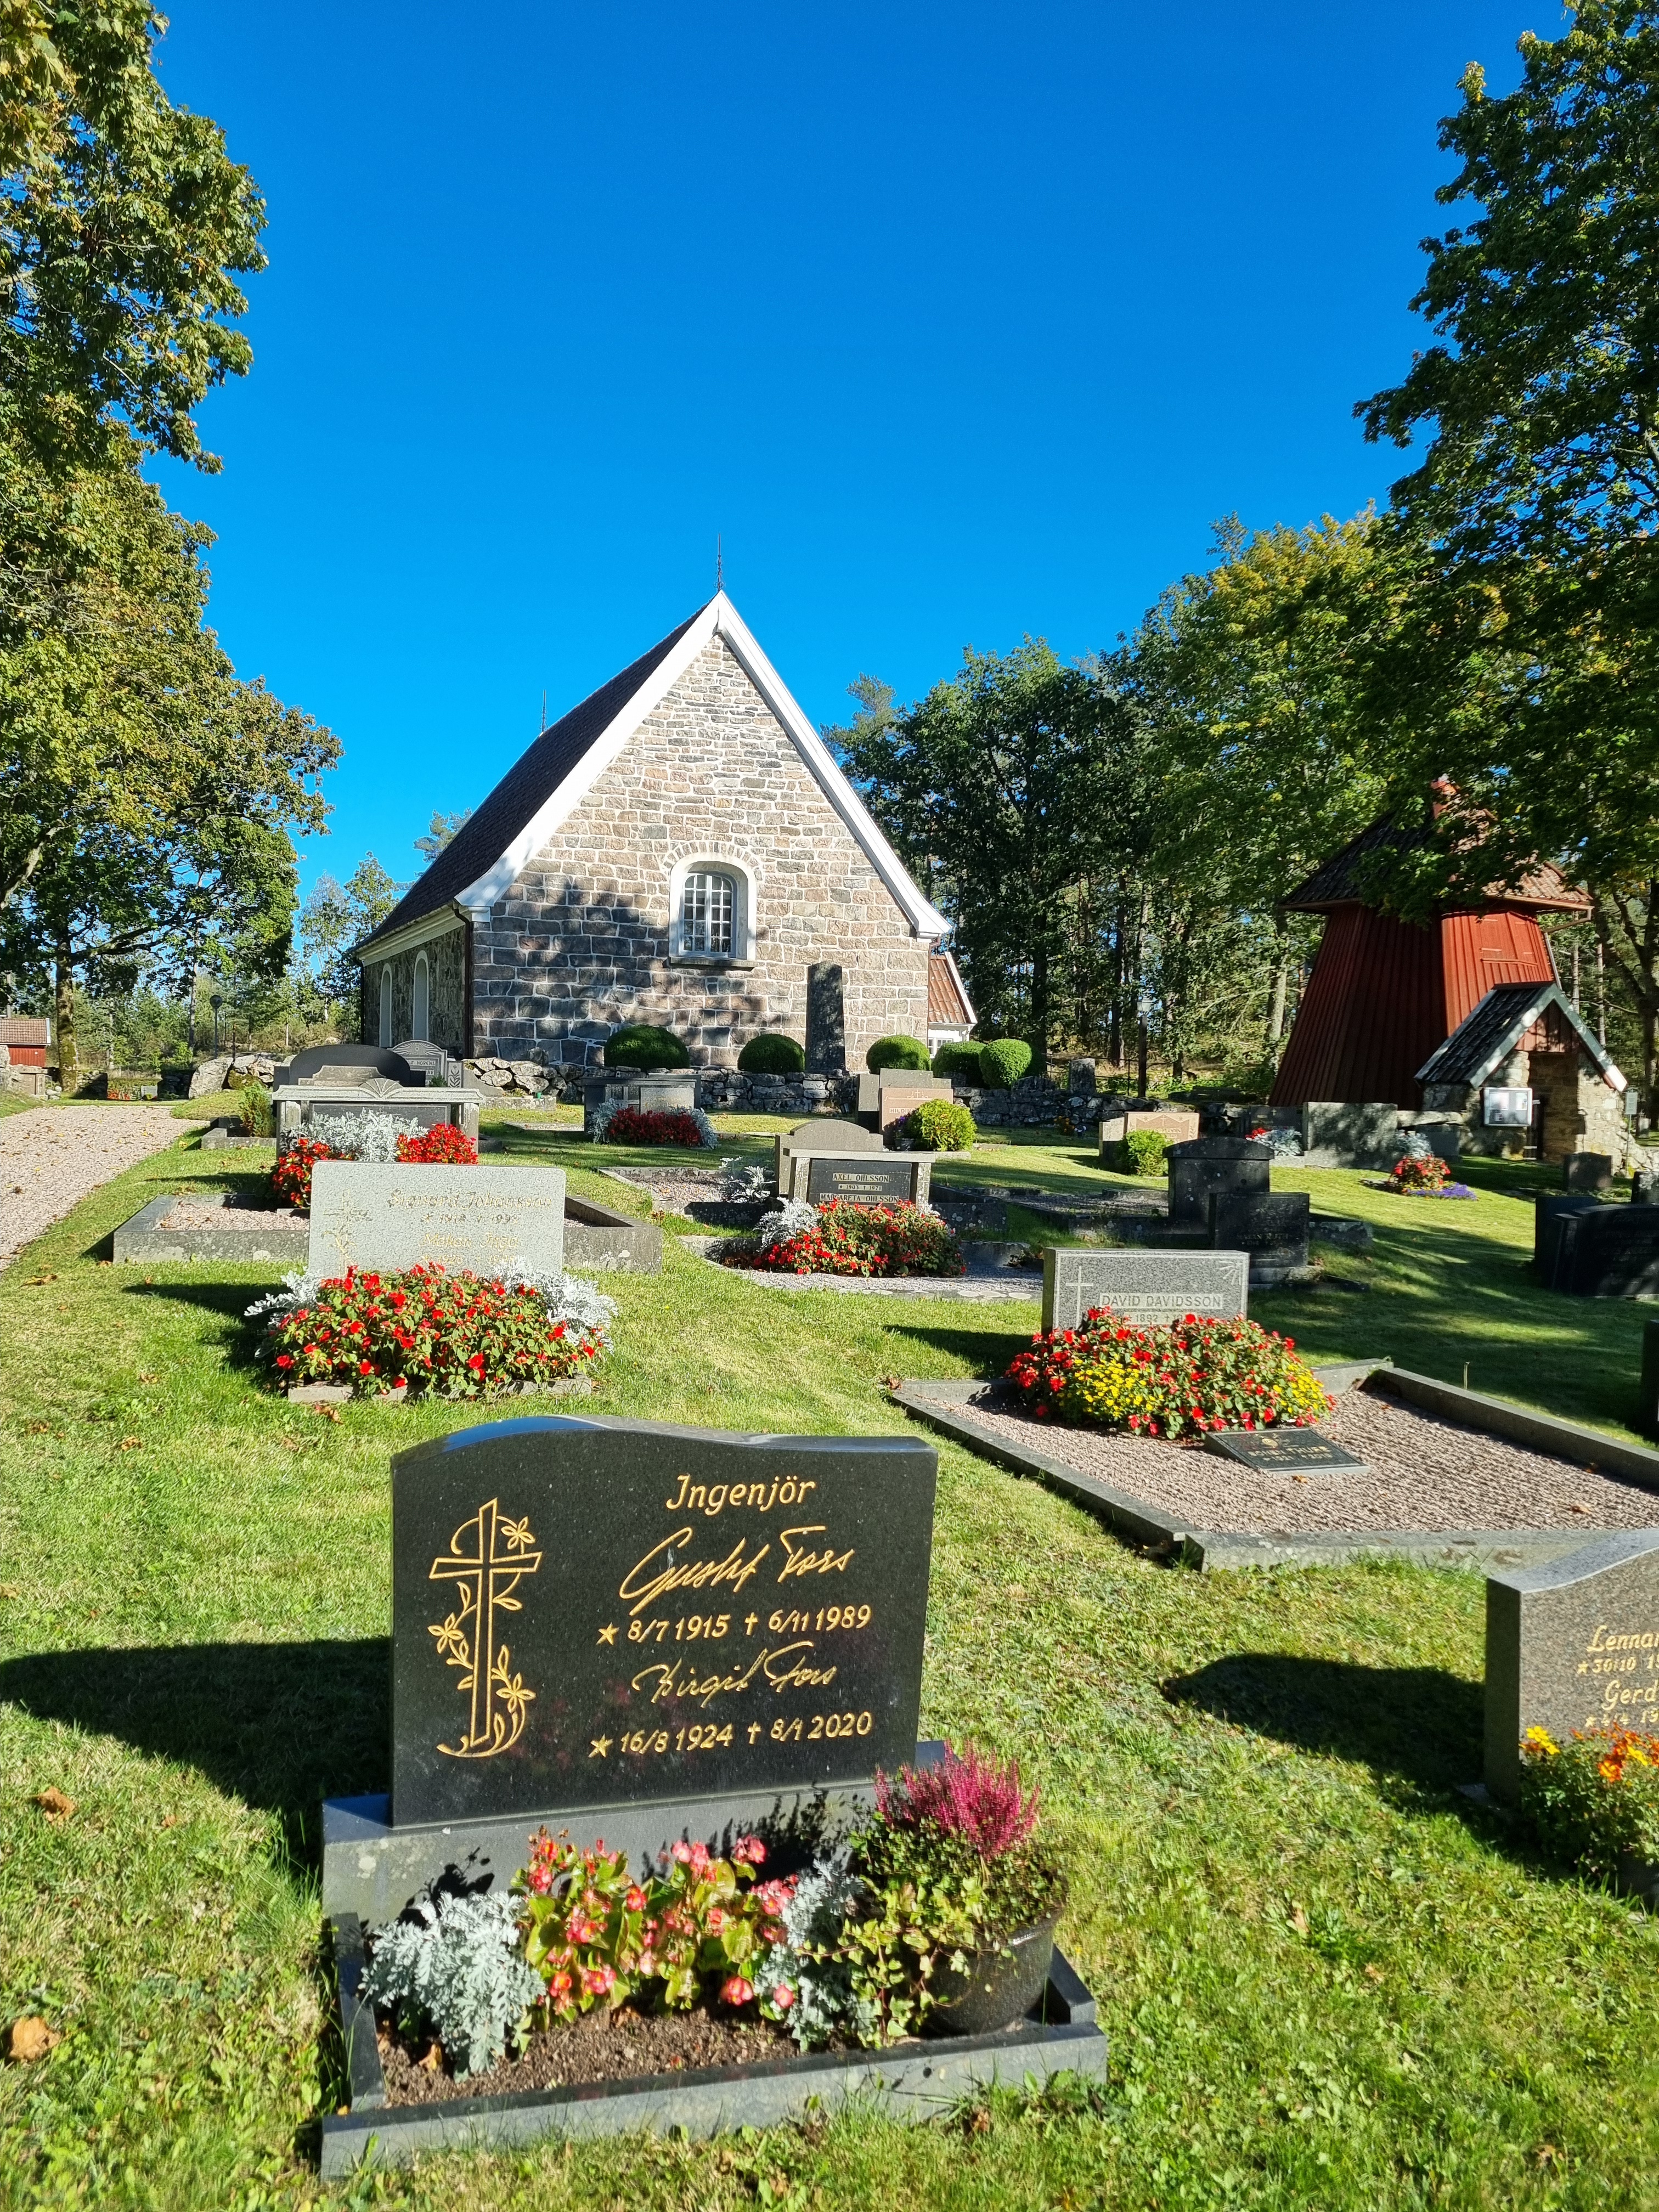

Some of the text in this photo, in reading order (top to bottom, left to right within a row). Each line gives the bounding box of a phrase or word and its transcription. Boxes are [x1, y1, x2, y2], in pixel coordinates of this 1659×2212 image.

[461, 1192, 552, 1210] Johansson
[820, 1193, 861, 1201] MARGARETA
[1102, 1295, 1221, 1307] DAVID DAVIDSSON
[1136, 1313, 1158, 1322] 1892
[675, 1613, 731, 1640] 1915
[815, 1604, 872, 1630] 1989
[1601, 1679, 1659, 1711] Gerd
[675, 1723, 733, 1751] 1924
[807, 1711, 873, 1740] 2020
